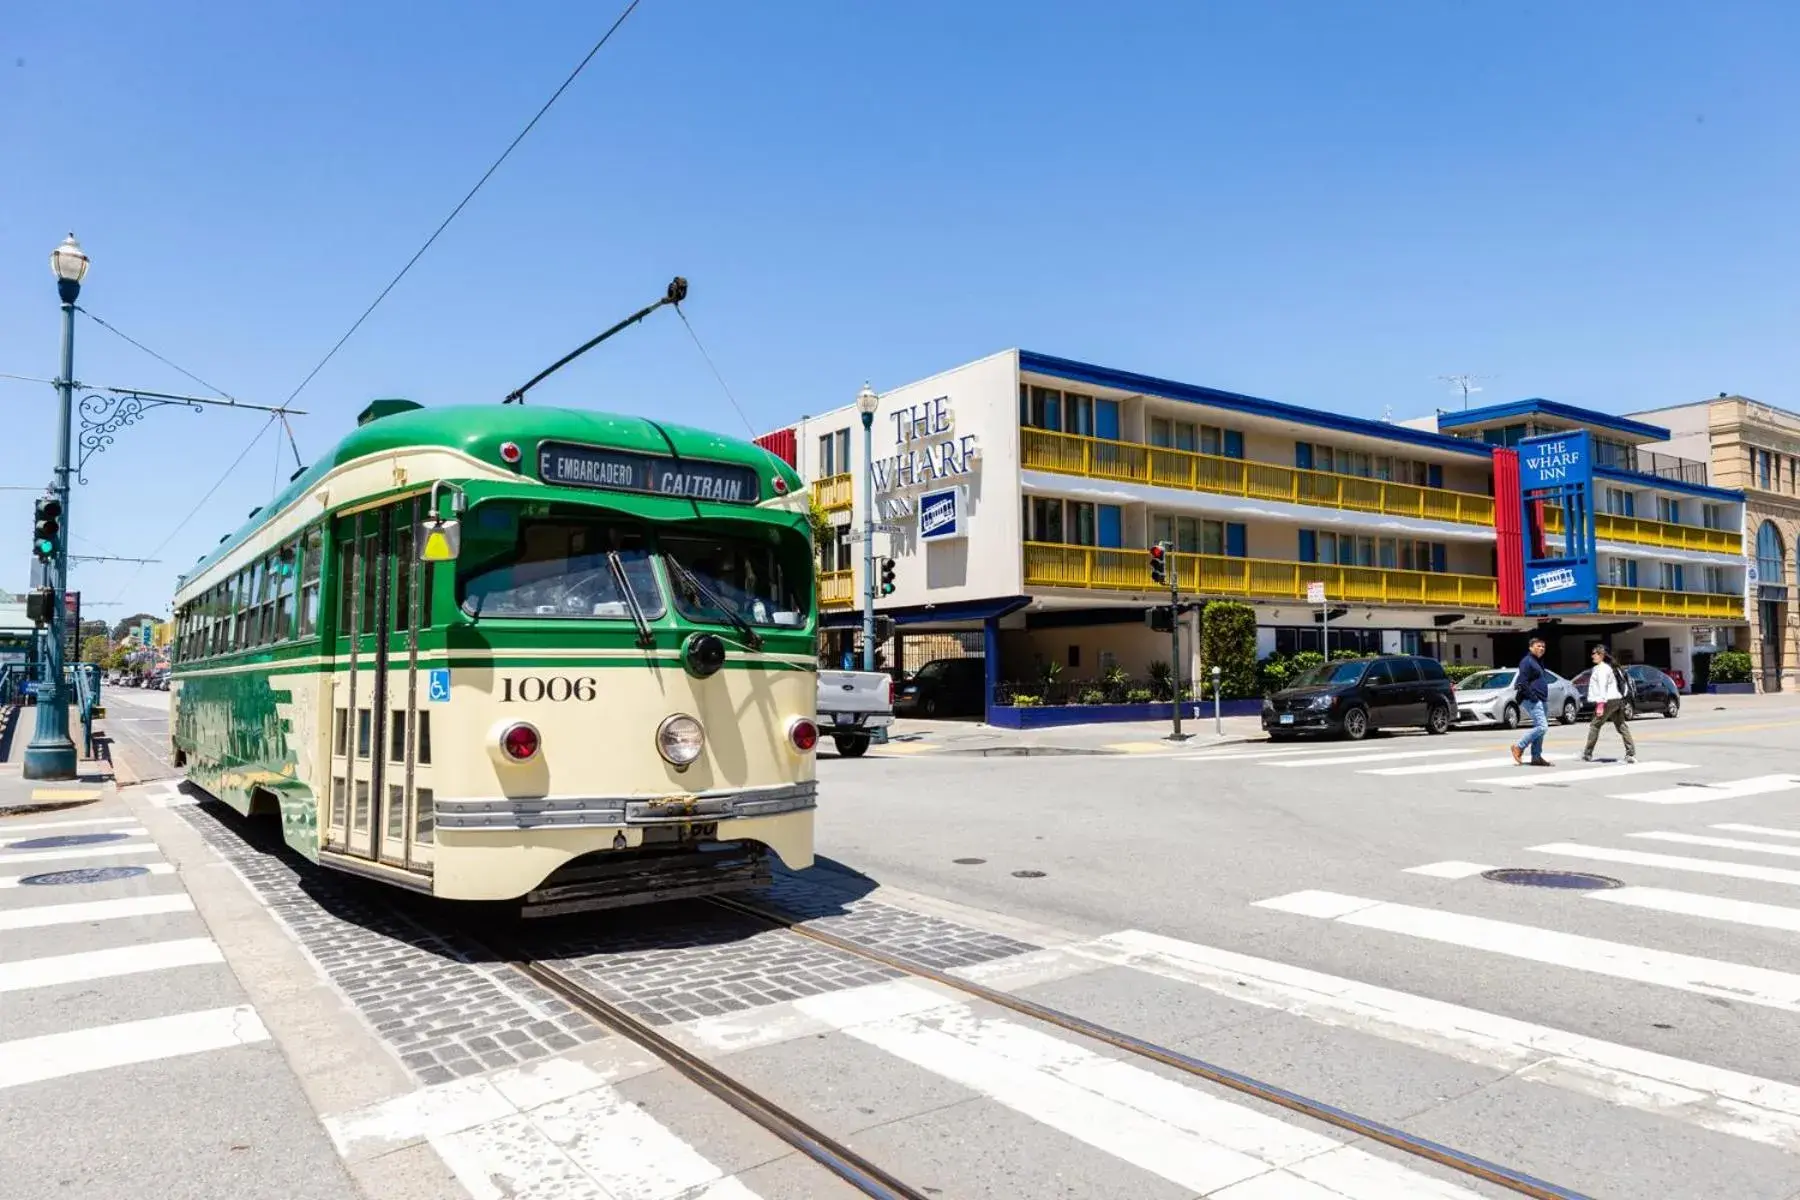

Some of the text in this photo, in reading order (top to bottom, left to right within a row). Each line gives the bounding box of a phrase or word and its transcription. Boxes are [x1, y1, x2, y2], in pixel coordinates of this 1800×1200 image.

[890, 395, 949, 445] THE
[1526, 451, 1579, 470] WHARF
[1537, 441, 1567, 456] THE
[871, 434, 976, 492] WHARF
[1540, 467, 1566, 481] INN
[541, 452, 742, 501] E EMBARCADERO CALTRAIN
[500, 676, 598, 702] 1006
